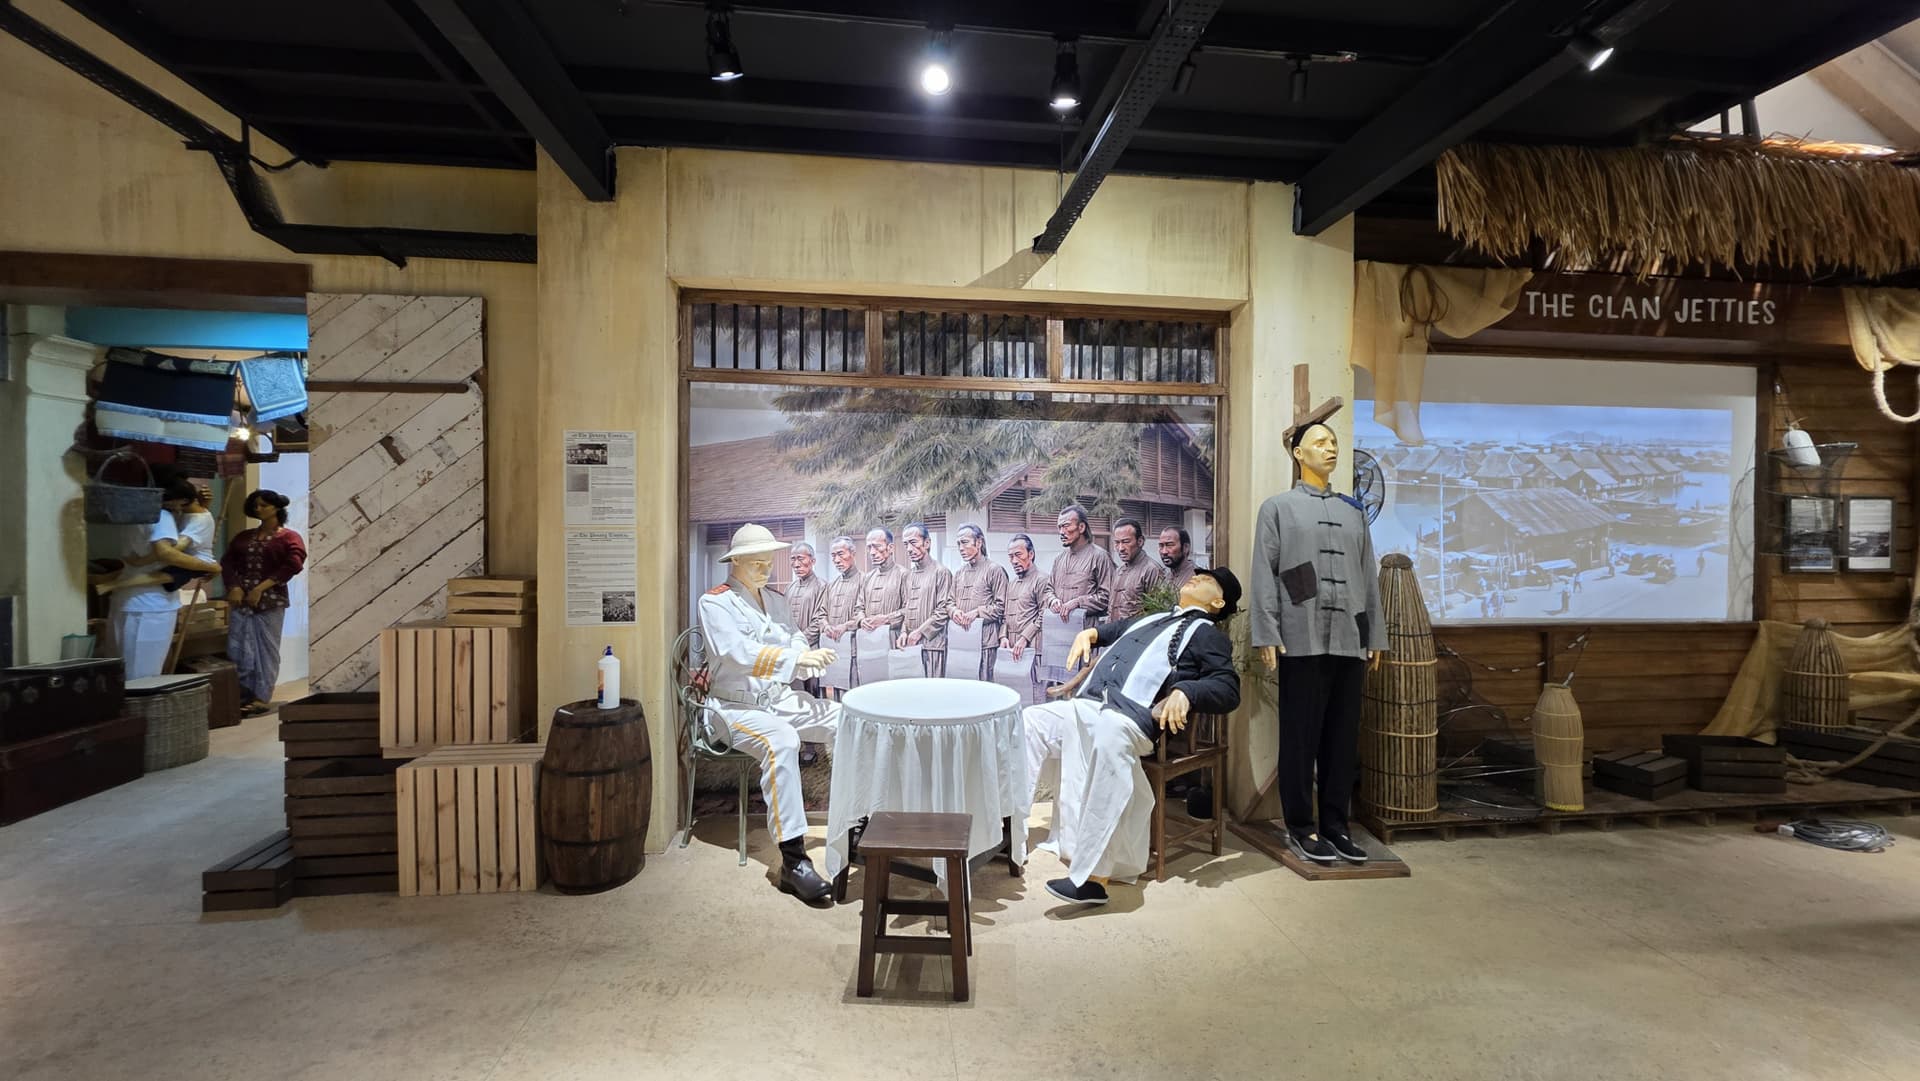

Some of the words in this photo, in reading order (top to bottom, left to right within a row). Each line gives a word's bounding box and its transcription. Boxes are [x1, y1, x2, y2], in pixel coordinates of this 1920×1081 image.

[1525, 291, 1575, 318] THE
[1589, 294, 1661, 321] CLAN
[1674, 298, 1776, 325] JETTIES
